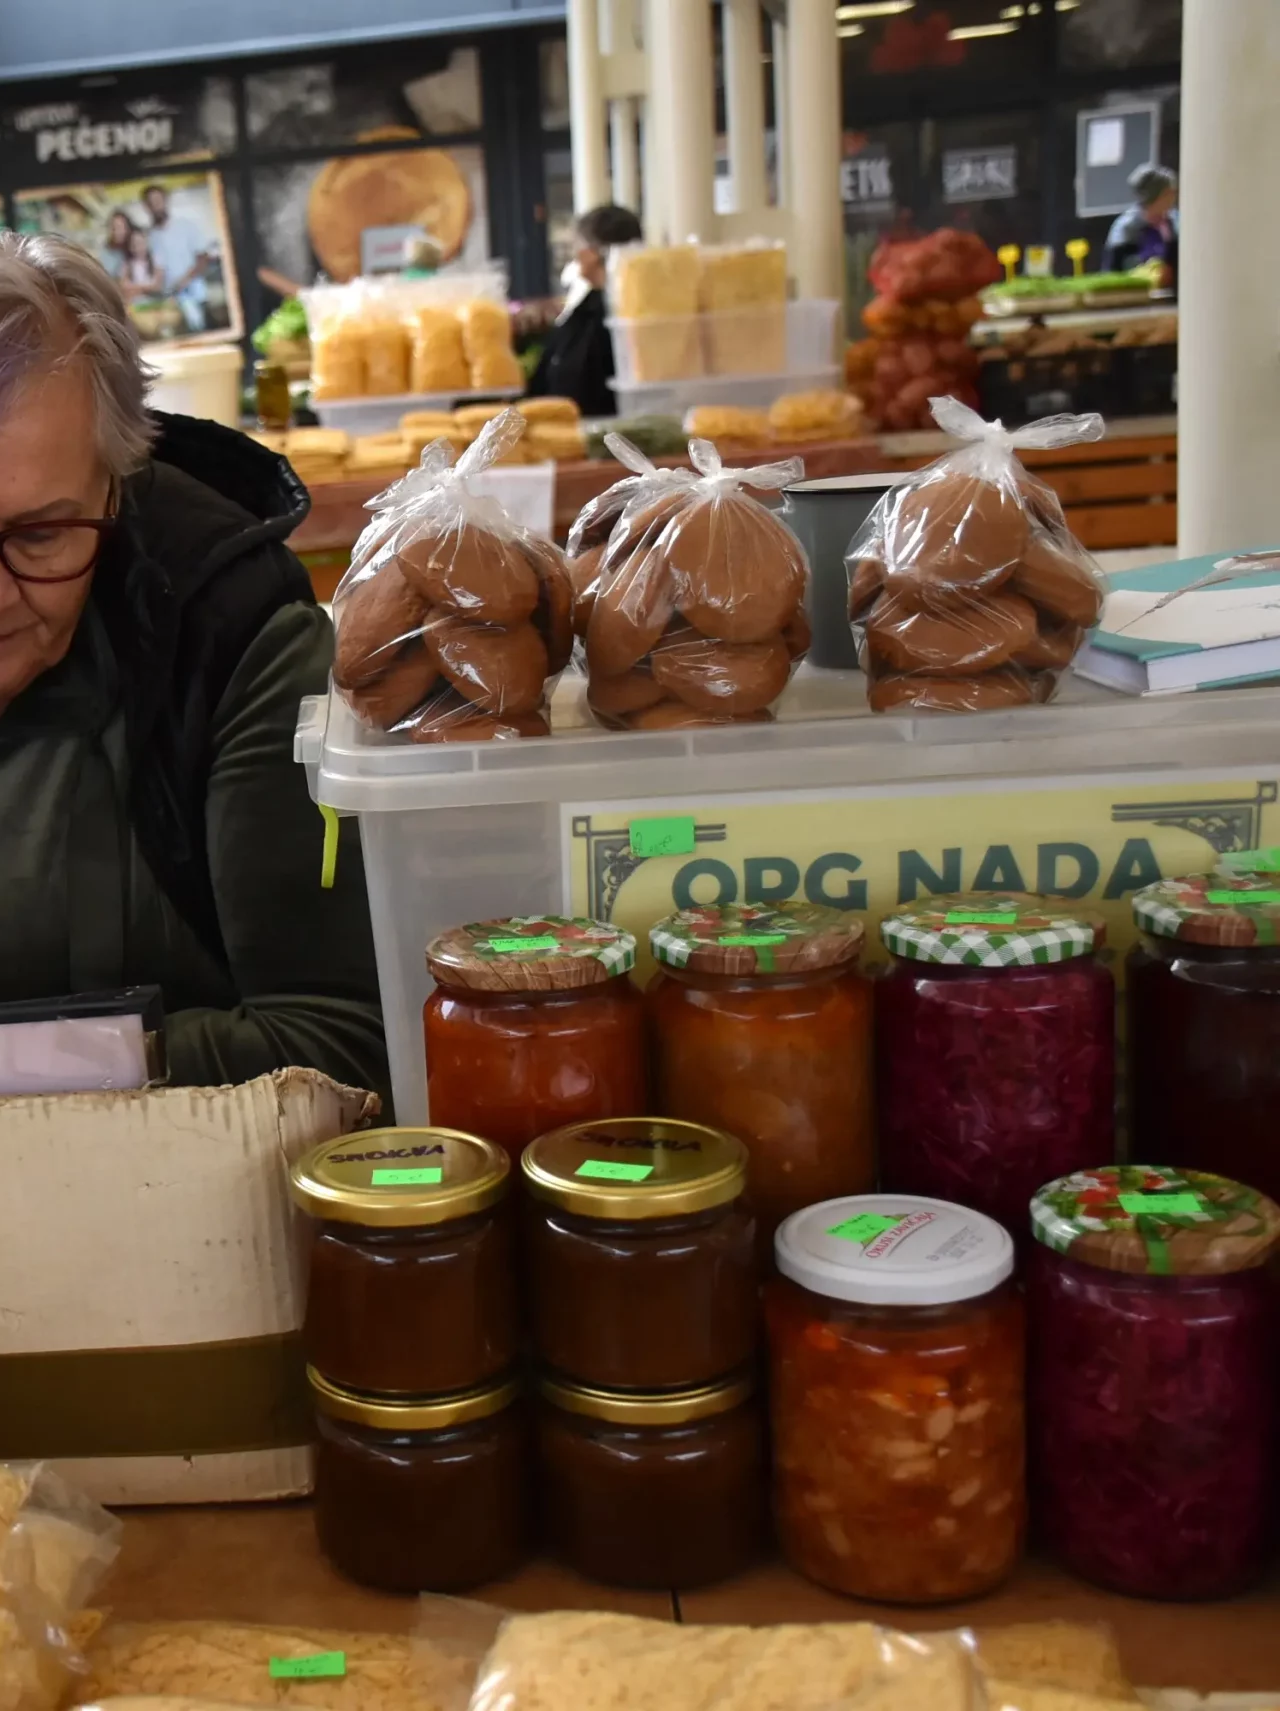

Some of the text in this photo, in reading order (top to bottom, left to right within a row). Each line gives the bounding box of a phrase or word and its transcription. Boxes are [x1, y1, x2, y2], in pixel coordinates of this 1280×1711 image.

[671, 838, 1164, 911] OPG NADA
[326, 1144, 446, 1165] SMOKVA
